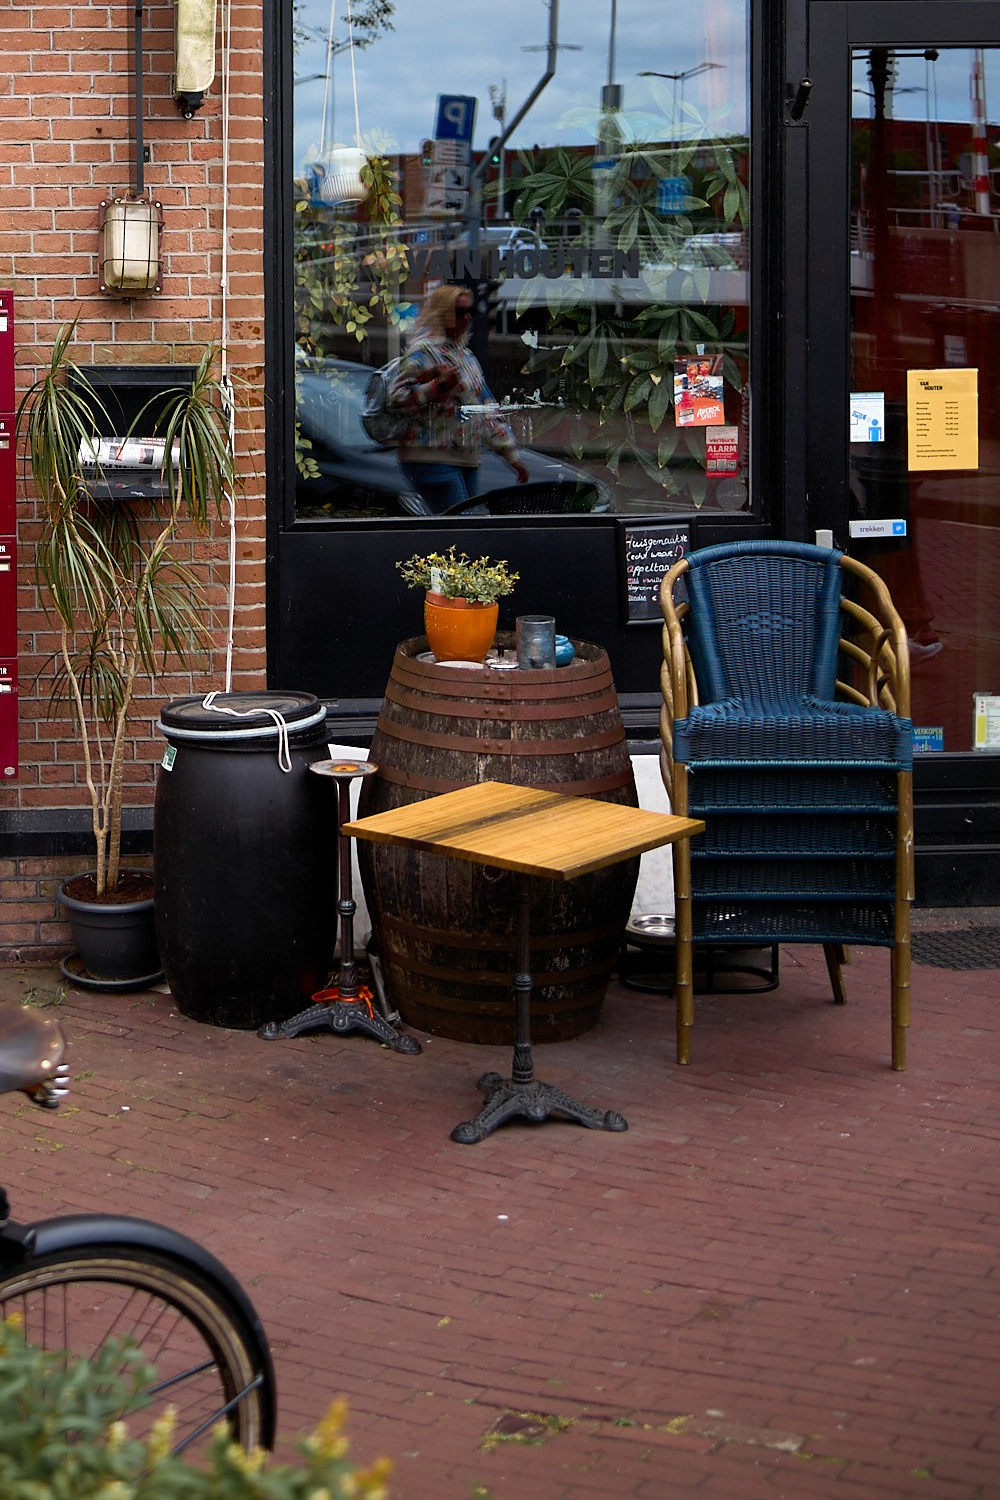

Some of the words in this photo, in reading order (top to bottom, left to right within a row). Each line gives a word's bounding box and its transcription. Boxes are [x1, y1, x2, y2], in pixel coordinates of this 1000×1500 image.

[405, 249, 482, 279] VAN
[491, 249, 640, 279] HOUTEN
[697, 405, 721, 417] APEROL
[707, 445, 737, 453] ALARM
[627, 562, 673, 576] appeltaa
